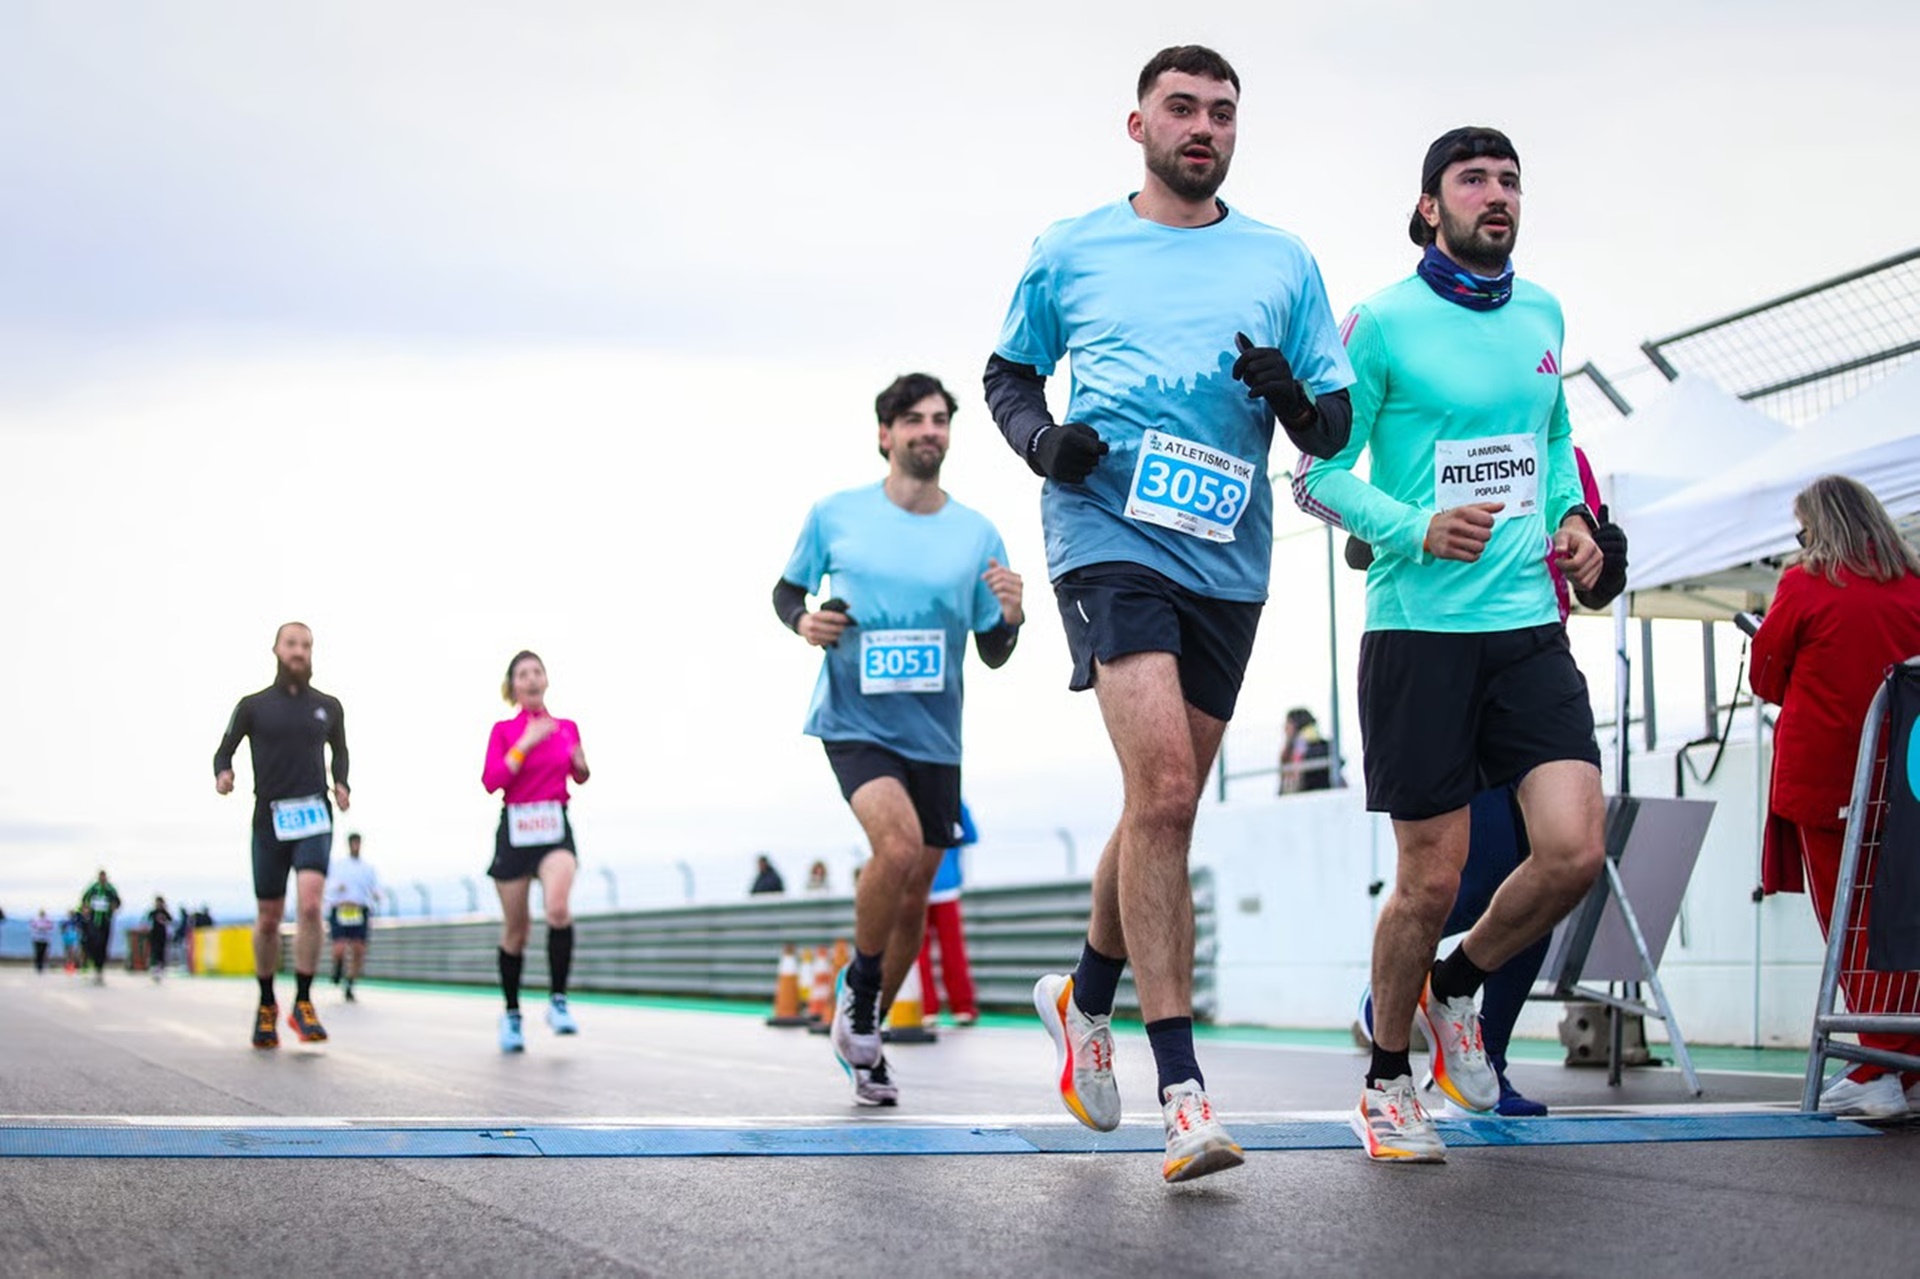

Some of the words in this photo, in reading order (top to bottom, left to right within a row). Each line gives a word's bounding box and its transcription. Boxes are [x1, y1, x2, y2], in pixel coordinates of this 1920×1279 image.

[1164, 441, 1231, 471] ATLETISMO
[1233, 464, 1251, 480] 10K
[1467, 448, 1477, 458] LA
[1478, 444, 1513, 456] INVERNAL
[1441, 457, 1535, 484] ATLETISMO
[1142, 461, 1241, 519] 3058
[1474, 484, 1511, 497] POPULAR
[869, 648, 937, 676] 3051
